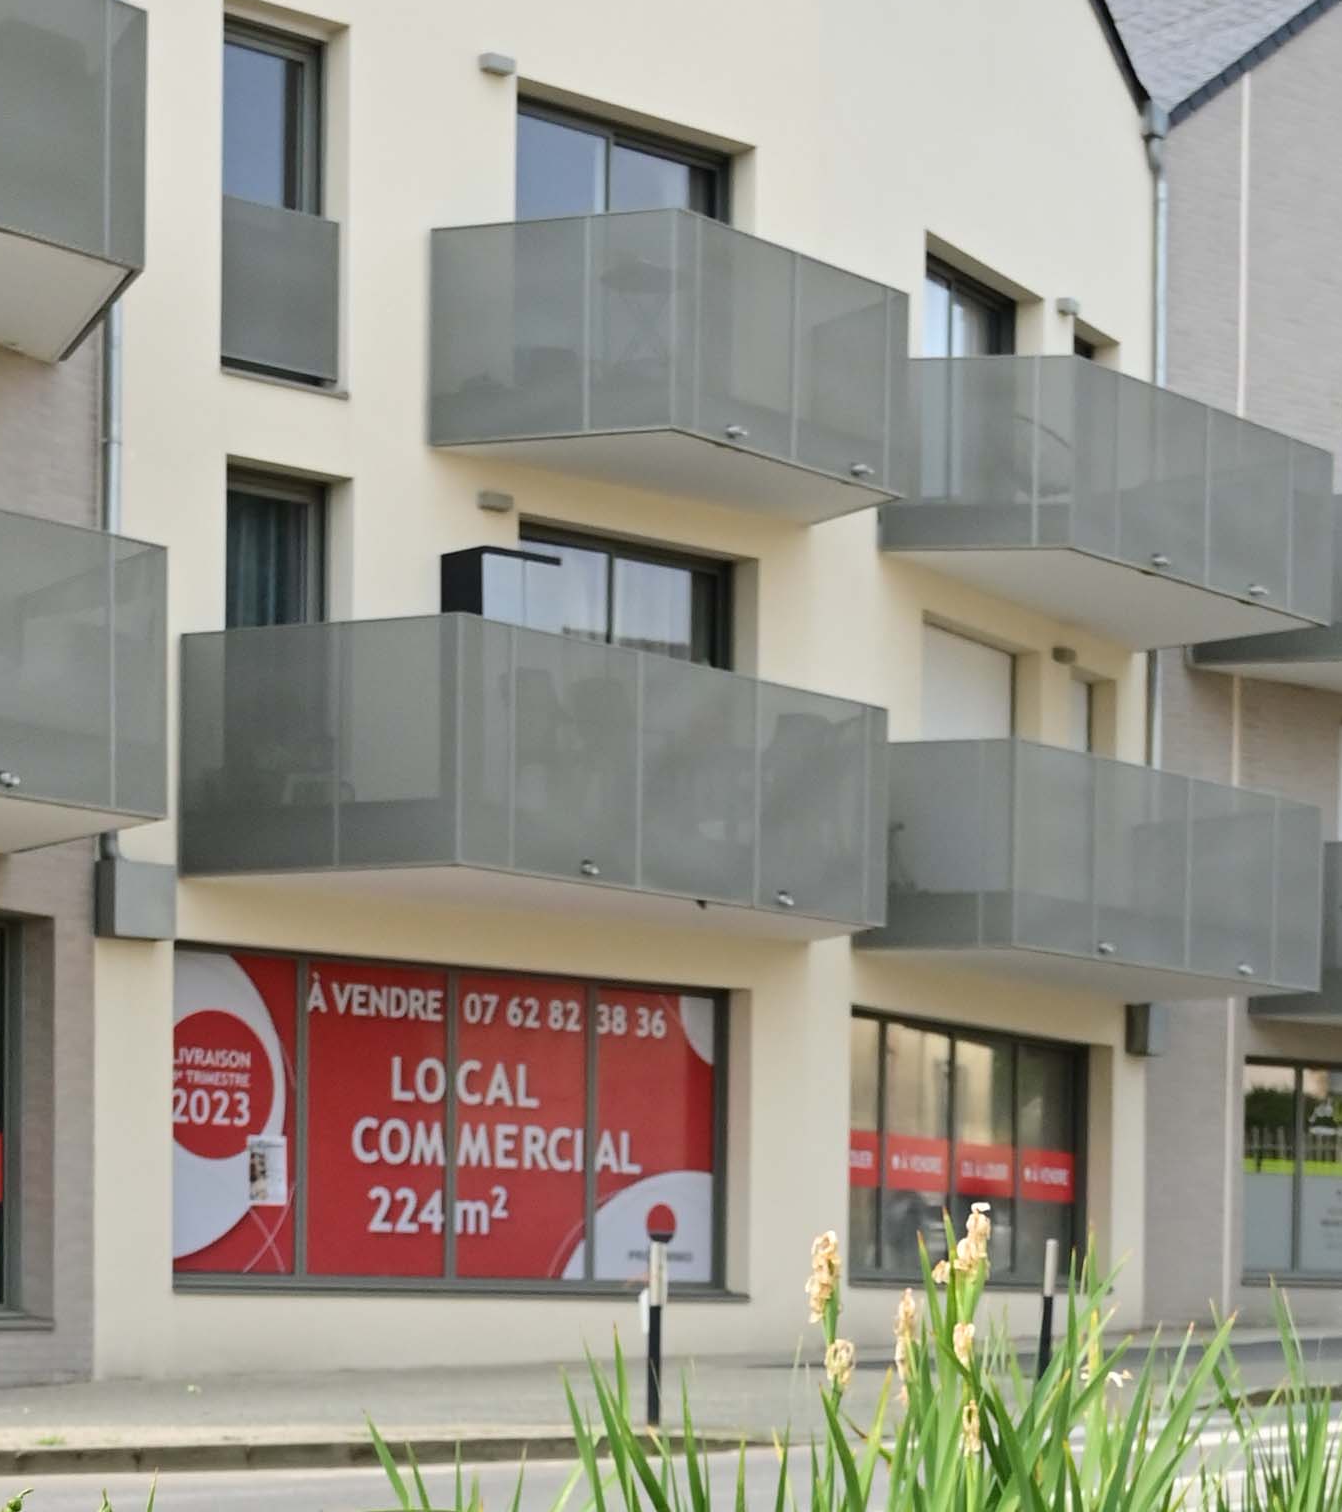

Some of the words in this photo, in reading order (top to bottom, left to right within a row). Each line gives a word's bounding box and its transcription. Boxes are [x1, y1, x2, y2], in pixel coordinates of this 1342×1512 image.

[308, 972, 327, 1014] À
[332, 983, 444, 1022] VENDRE
[464, 994, 499, 1025] 07
[507, 997, 540, 1029] 62
[548, 1000, 581, 1032] 82
[596, 1004, 627, 1036] 38
[636, 1007, 667, 1038] 36
[187, 1069, 251, 1088] TRIMESTRE
[391, 1056, 540, 1109] LOCAL
[172, 1088, 251, 1127] 2023
[352, 1116, 642, 1175] COMMERCIAL
[368, 1185, 444, 1234] 224
